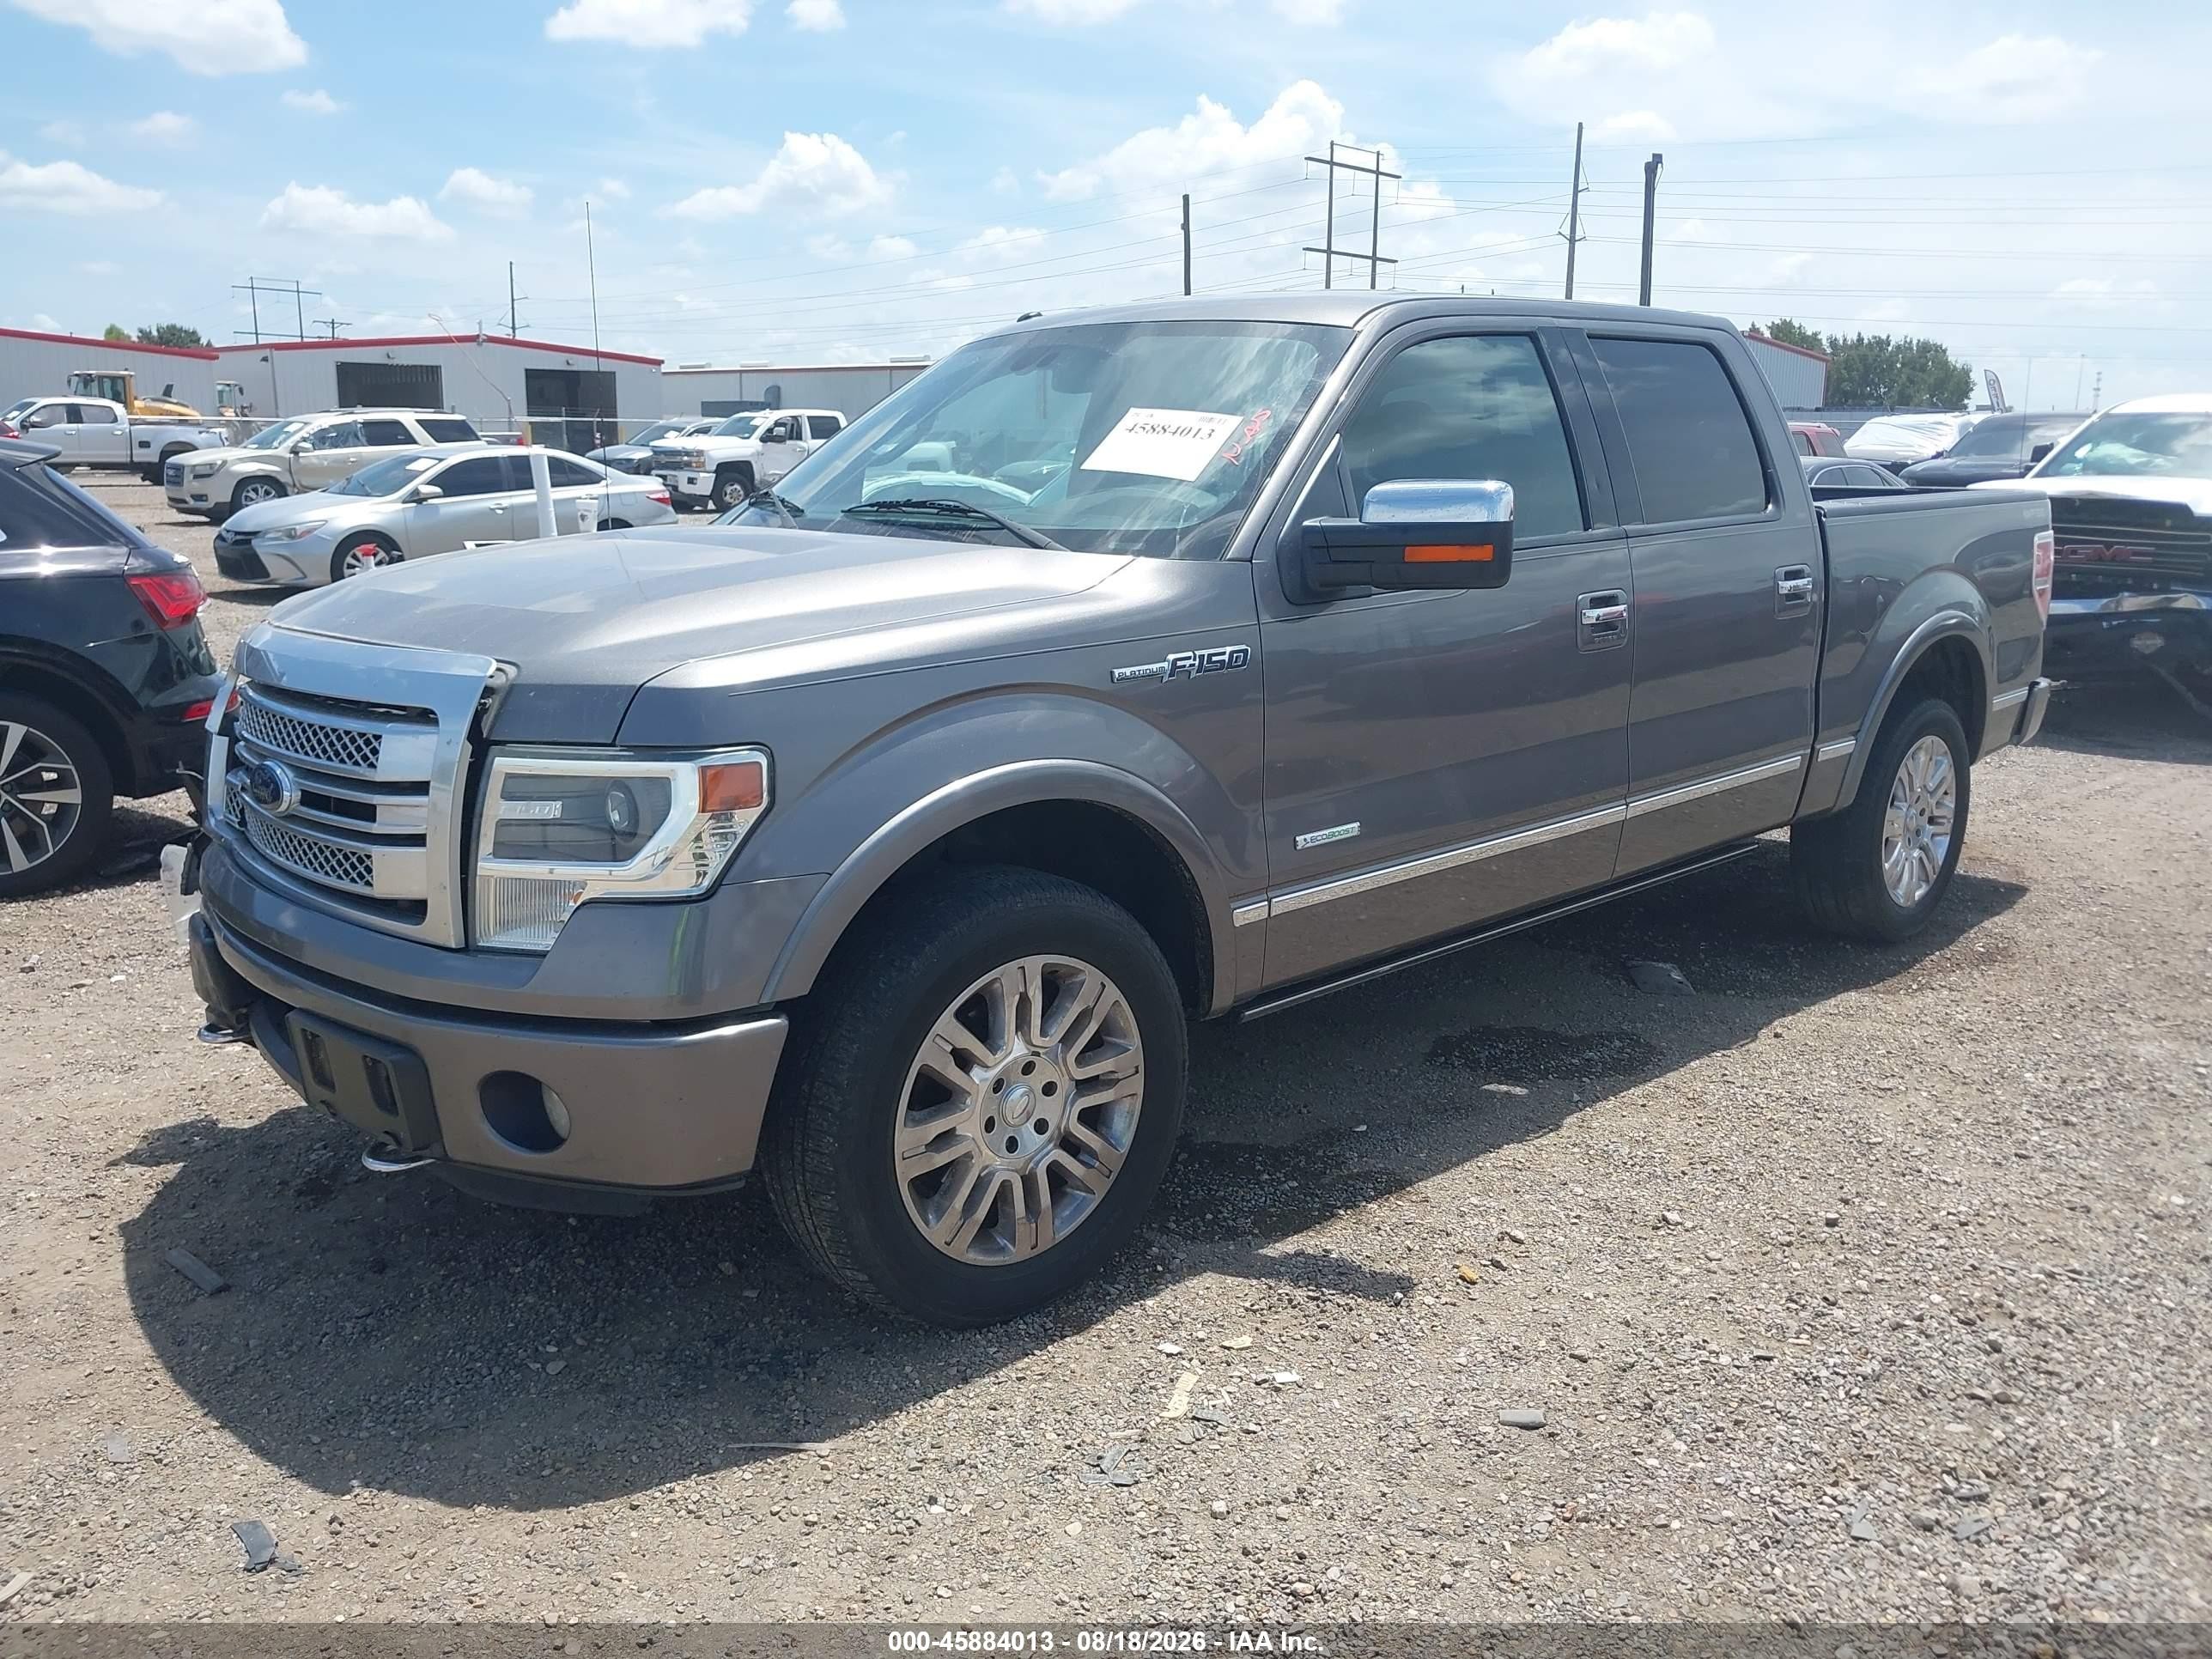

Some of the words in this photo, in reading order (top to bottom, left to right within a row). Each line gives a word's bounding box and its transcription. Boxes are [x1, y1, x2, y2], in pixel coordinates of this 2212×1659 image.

[1126, 422, 1215, 440] 45884013
[2063, 544, 2156, 563] GMC
[1116, 665, 1167, 679] PLATINUM
[1163, 644, 1251, 682] F-150
